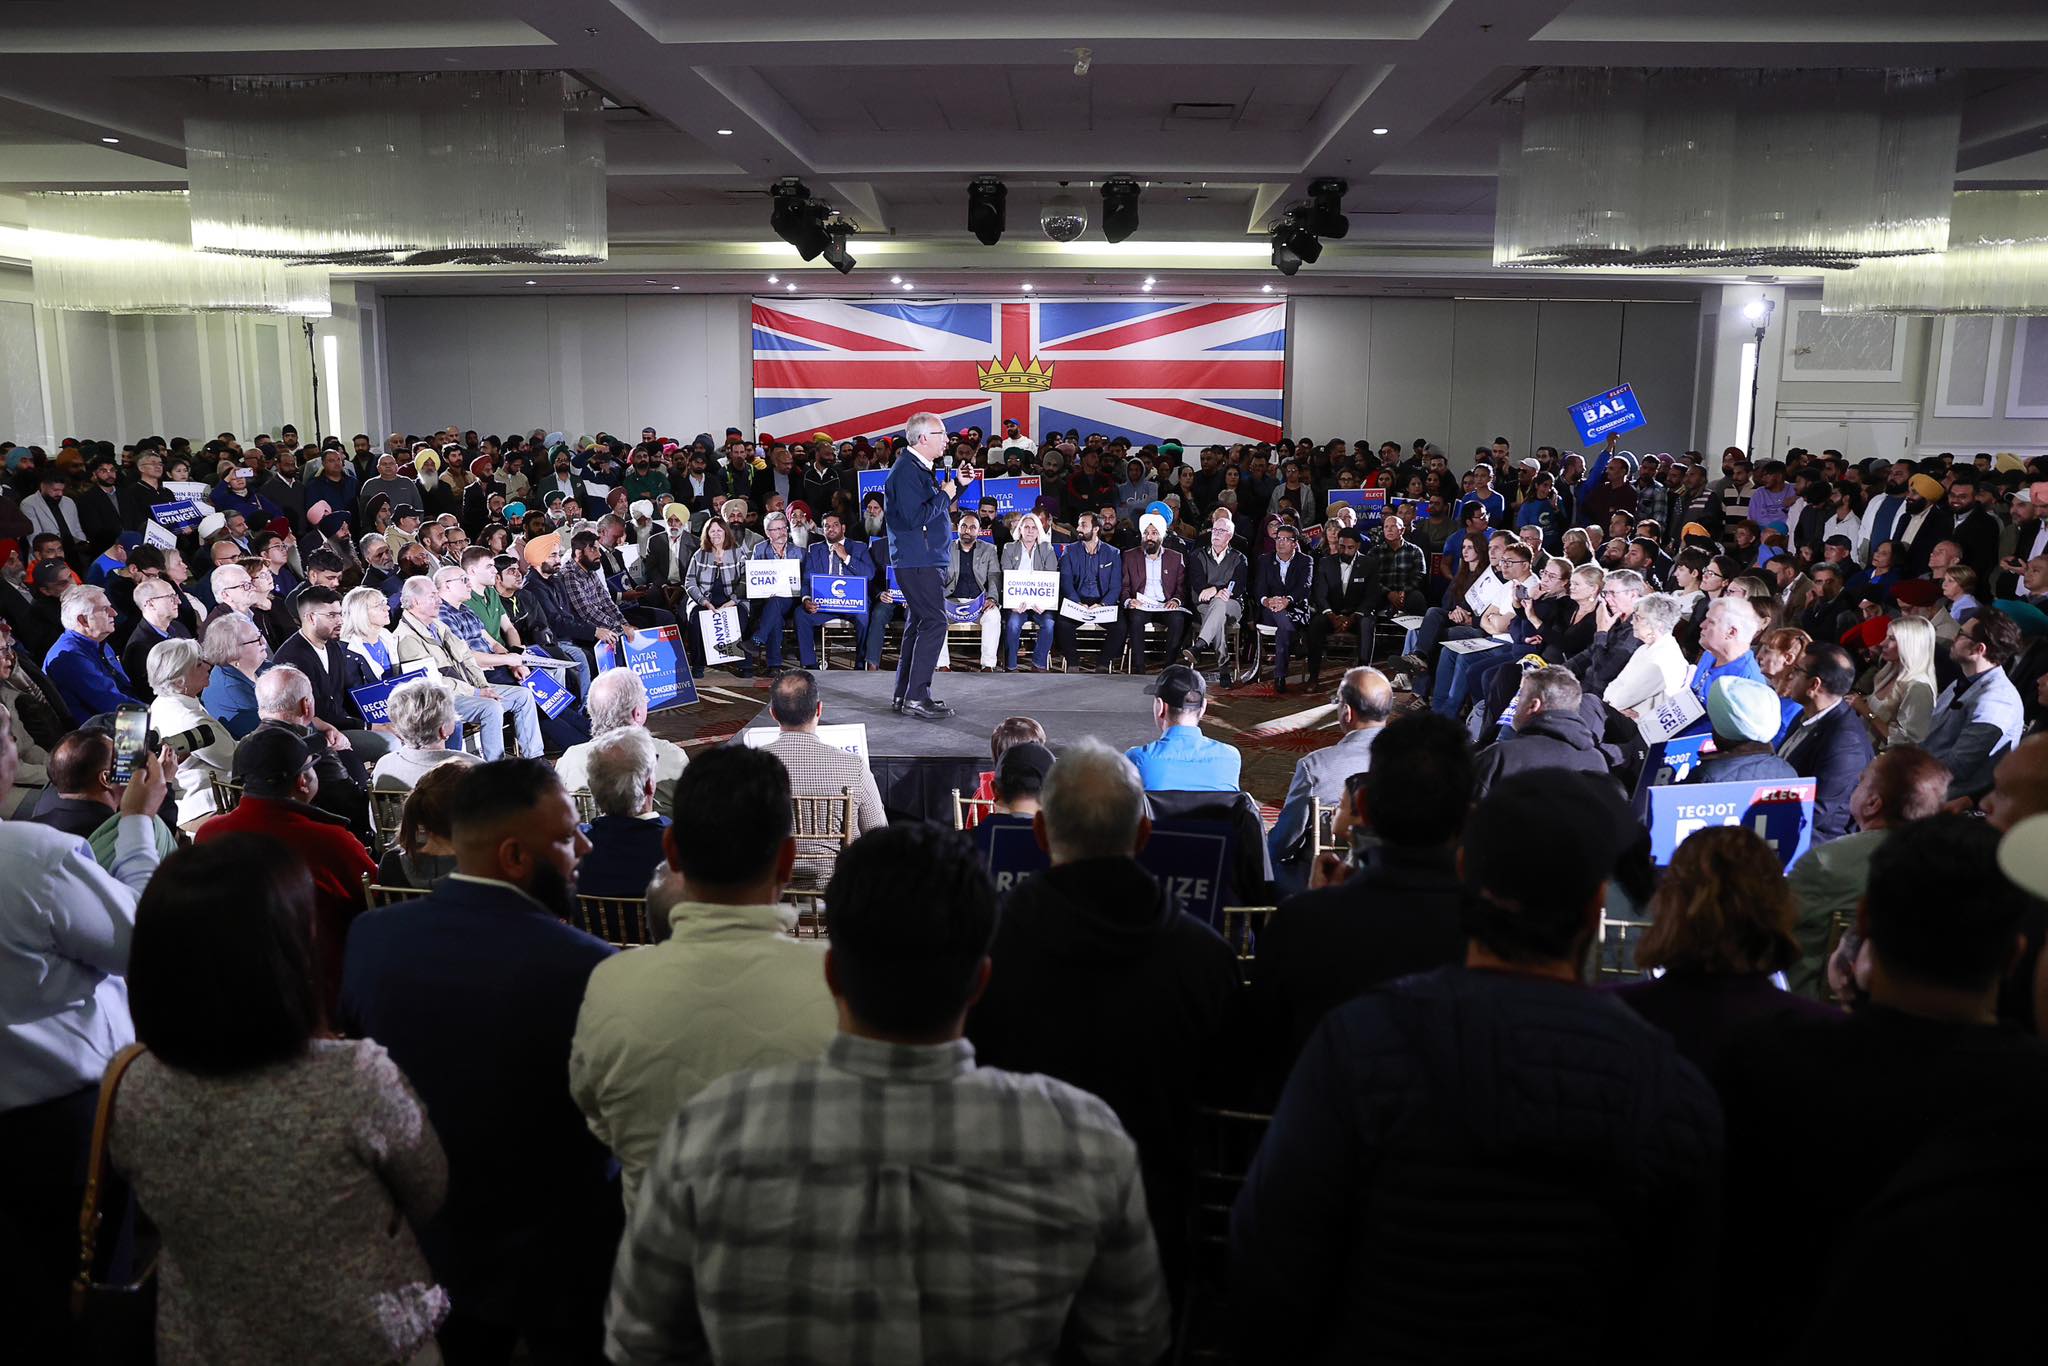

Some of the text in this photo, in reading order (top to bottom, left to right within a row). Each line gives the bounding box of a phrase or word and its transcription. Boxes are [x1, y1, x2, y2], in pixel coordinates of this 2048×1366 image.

[1609, 386, 1628, 397] ELECT
[1583, 398, 1626, 424] BAL
[160, 511, 200, 525] CHANGE!
[1008, 587, 1055, 597] CHANGE!
[815, 598, 864, 607] CONSERVATIVE
[721, 611, 731, 639] COMMON
[660, 630, 678, 638] ELECT
[713, 612, 729, 659] CHANGE!
[631, 651, 658, 663] AVTAR
[632, 660, 661, 676] GILL
[649, 681, 692, 696] CONSERVATIVE
[1672, 706, 1688, 725] SENSE
[1761, 787, 1809, 801] ELECT
[1676, 803, 1736, 818] TEGJOT
[1675, 815, 1779, 850] BL
